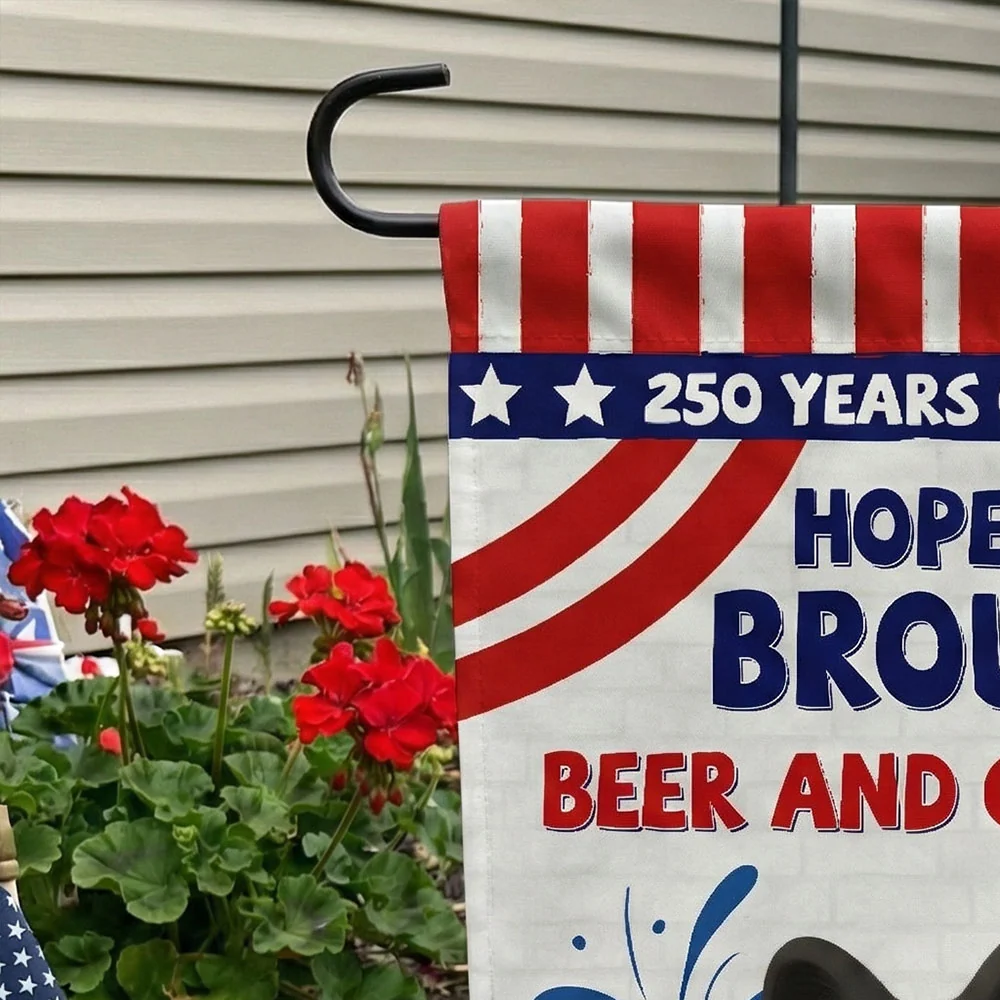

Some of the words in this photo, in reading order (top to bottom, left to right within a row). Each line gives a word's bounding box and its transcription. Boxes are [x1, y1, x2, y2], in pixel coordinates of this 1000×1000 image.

[644, 372, 762, 426] 250
[781, 372, 979, 427] YEARS
[543, 751, 750, 833] BEER
[771, 752, 960, 835] AND
